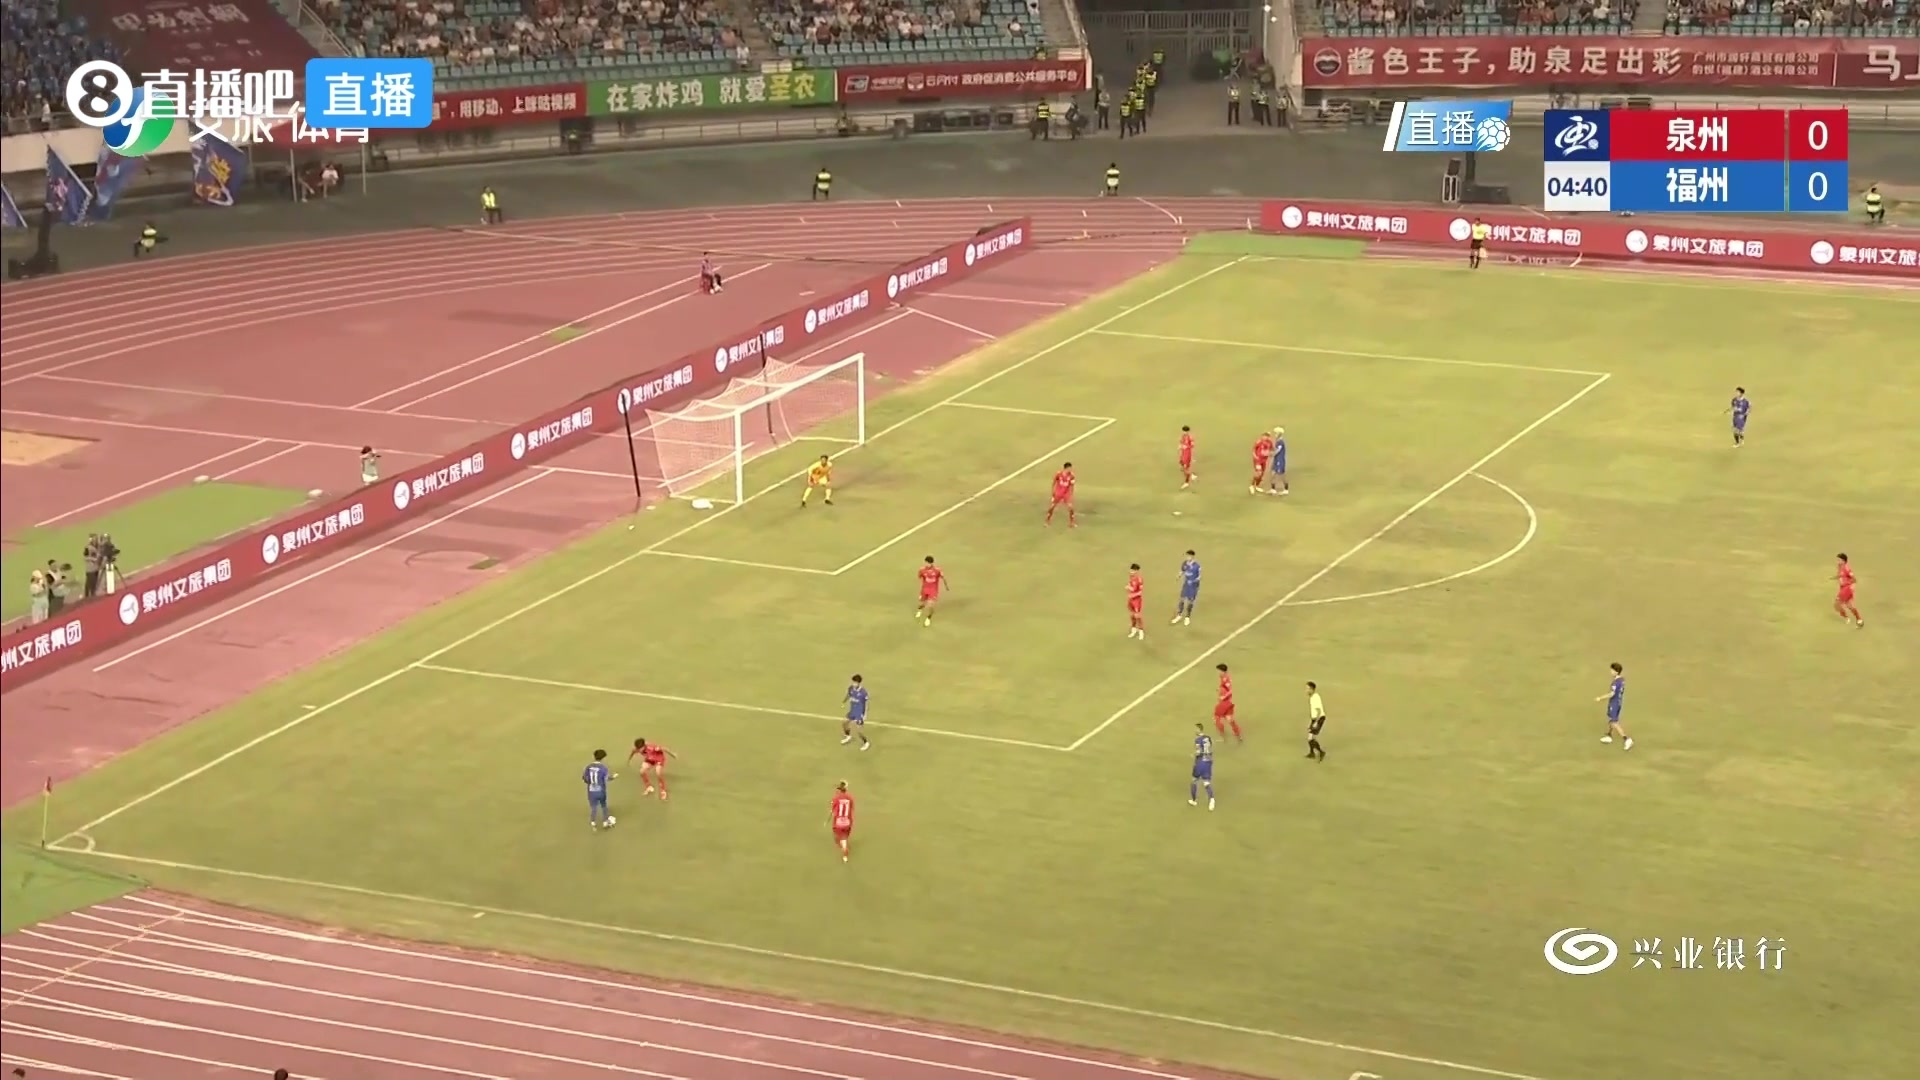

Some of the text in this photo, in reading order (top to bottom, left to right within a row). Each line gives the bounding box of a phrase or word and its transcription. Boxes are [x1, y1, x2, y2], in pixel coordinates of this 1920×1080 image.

[607, 74, 816, 112] 在家炸鸡 就爱圣农
[1306, 211, 1407, 234] 泉州文旅集团
[1653, 234, 1764, 258] 泉州文旅集团
[1839, 246, 1920, 266] 泉州文旅
[817, 289, 869, 326] 泉州文旅集团
[632, 364, 693, 405] 泉州文旅集团
[527, 406, 593, 450] 泉州文旅集团
[411, 452, 484, 500] 泉州文旅集团
[282, 503, 364, 553] 泉州文旅集团
[142, 558, 231, 613] 泉州文旅集团
